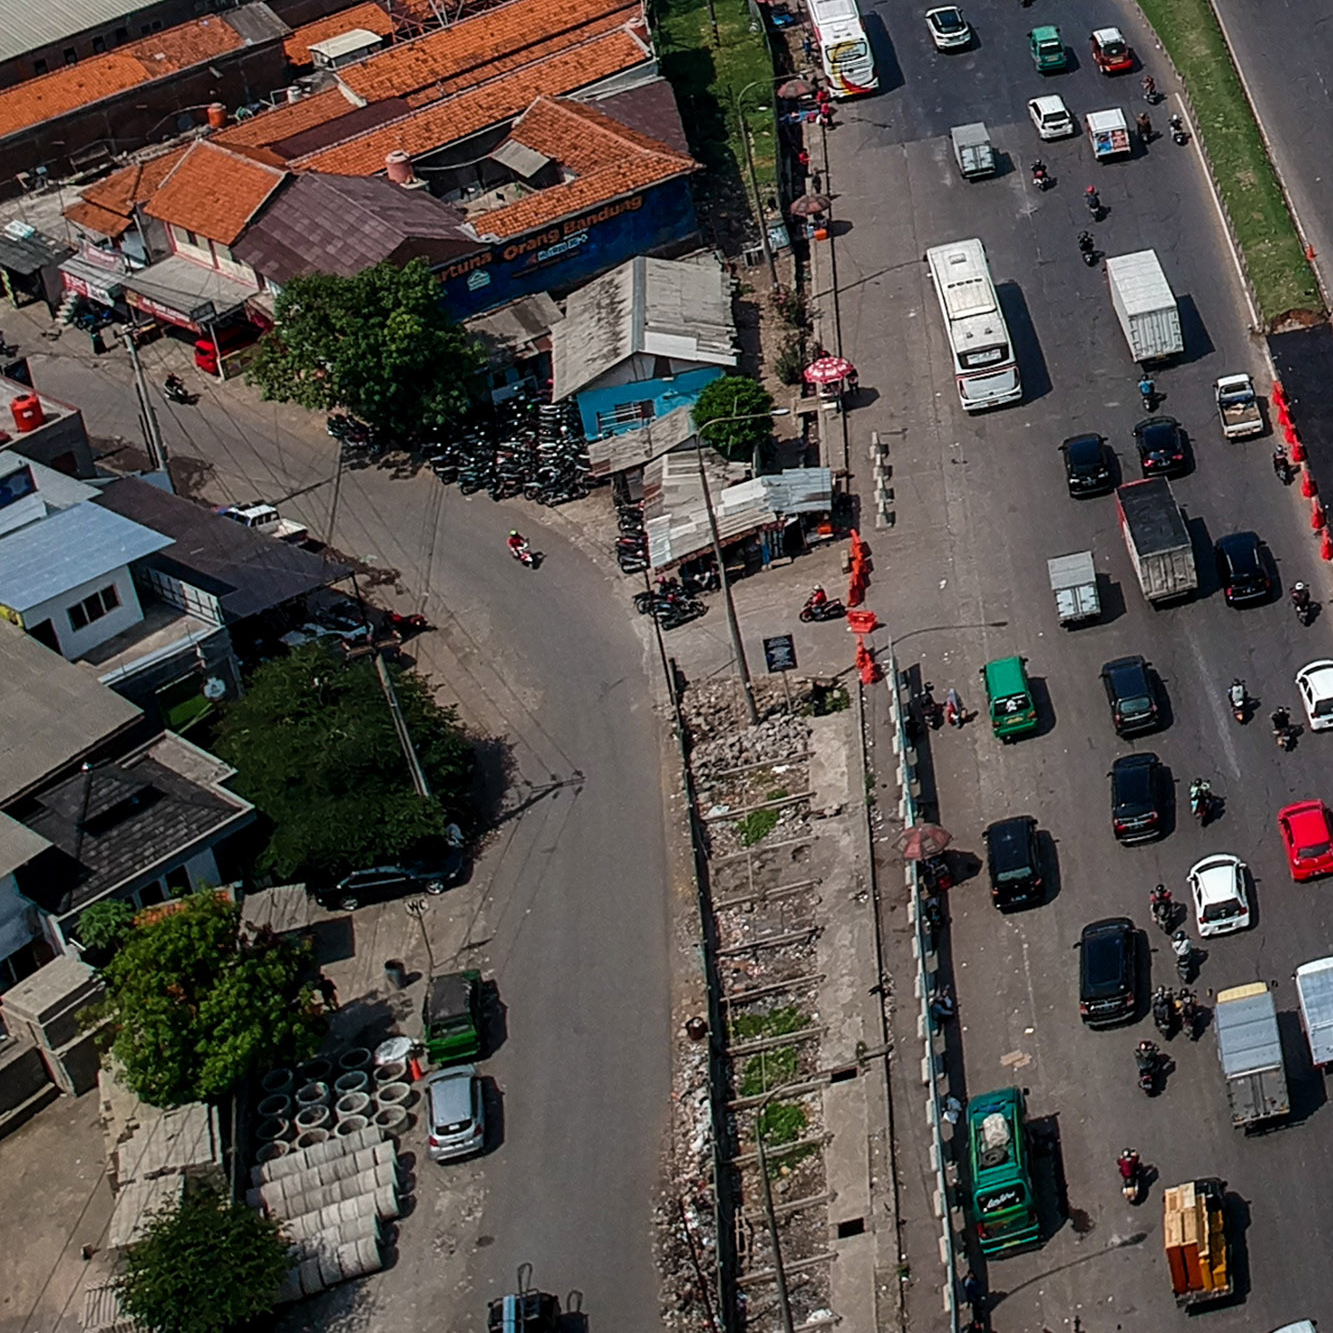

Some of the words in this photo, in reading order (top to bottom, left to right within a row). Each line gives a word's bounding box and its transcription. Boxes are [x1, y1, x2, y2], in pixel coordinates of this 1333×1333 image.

[503, 228, 561, 261] Orang
[563, 195, 643, 235] Bandung
[407, 898, 427, 912] WC
